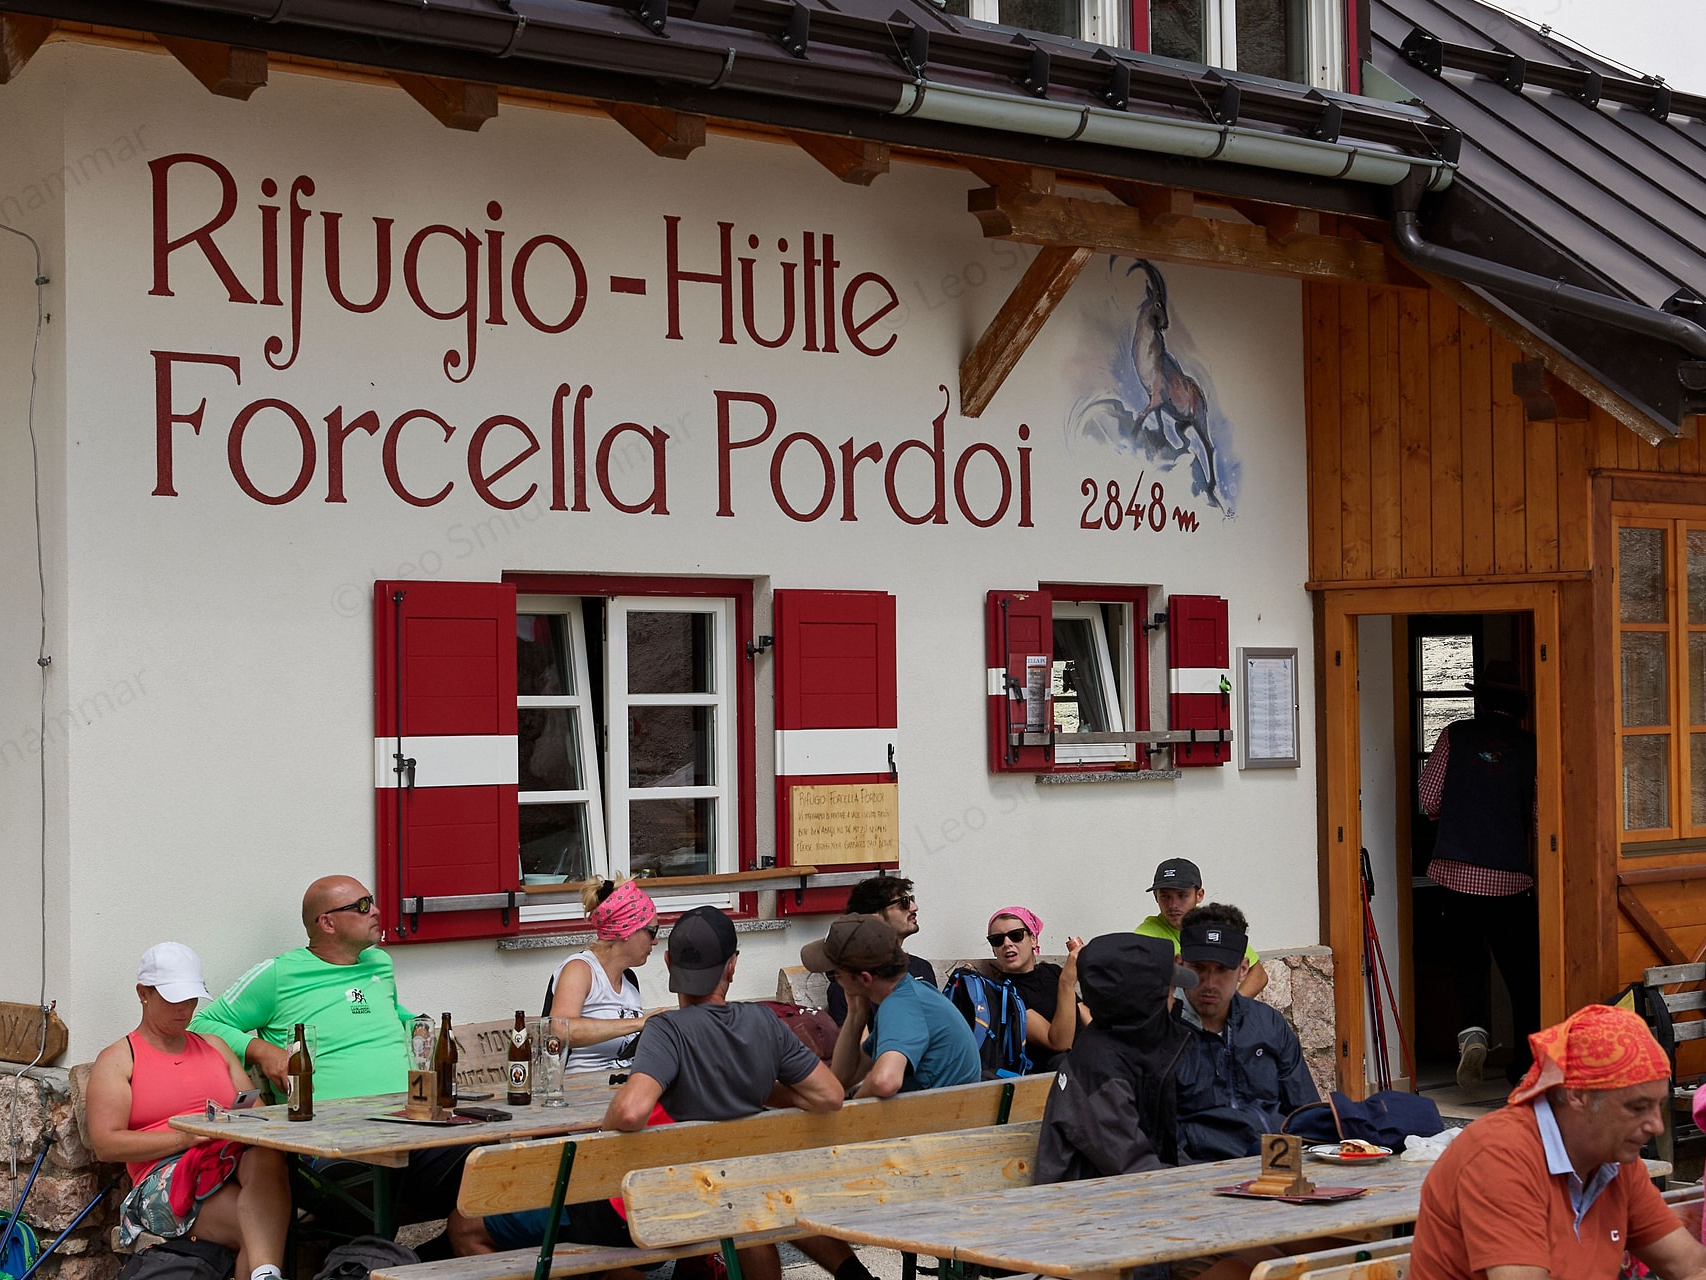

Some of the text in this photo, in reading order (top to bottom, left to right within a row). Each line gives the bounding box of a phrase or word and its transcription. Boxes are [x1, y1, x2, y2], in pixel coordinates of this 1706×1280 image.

[150, 349, 1034, 529] Forcella Pordoi
[1080, 470, 1167, 533] 2848
[412, 1074, 427, 1101] 1
[1269, 1138, 1292, 1169] 2
